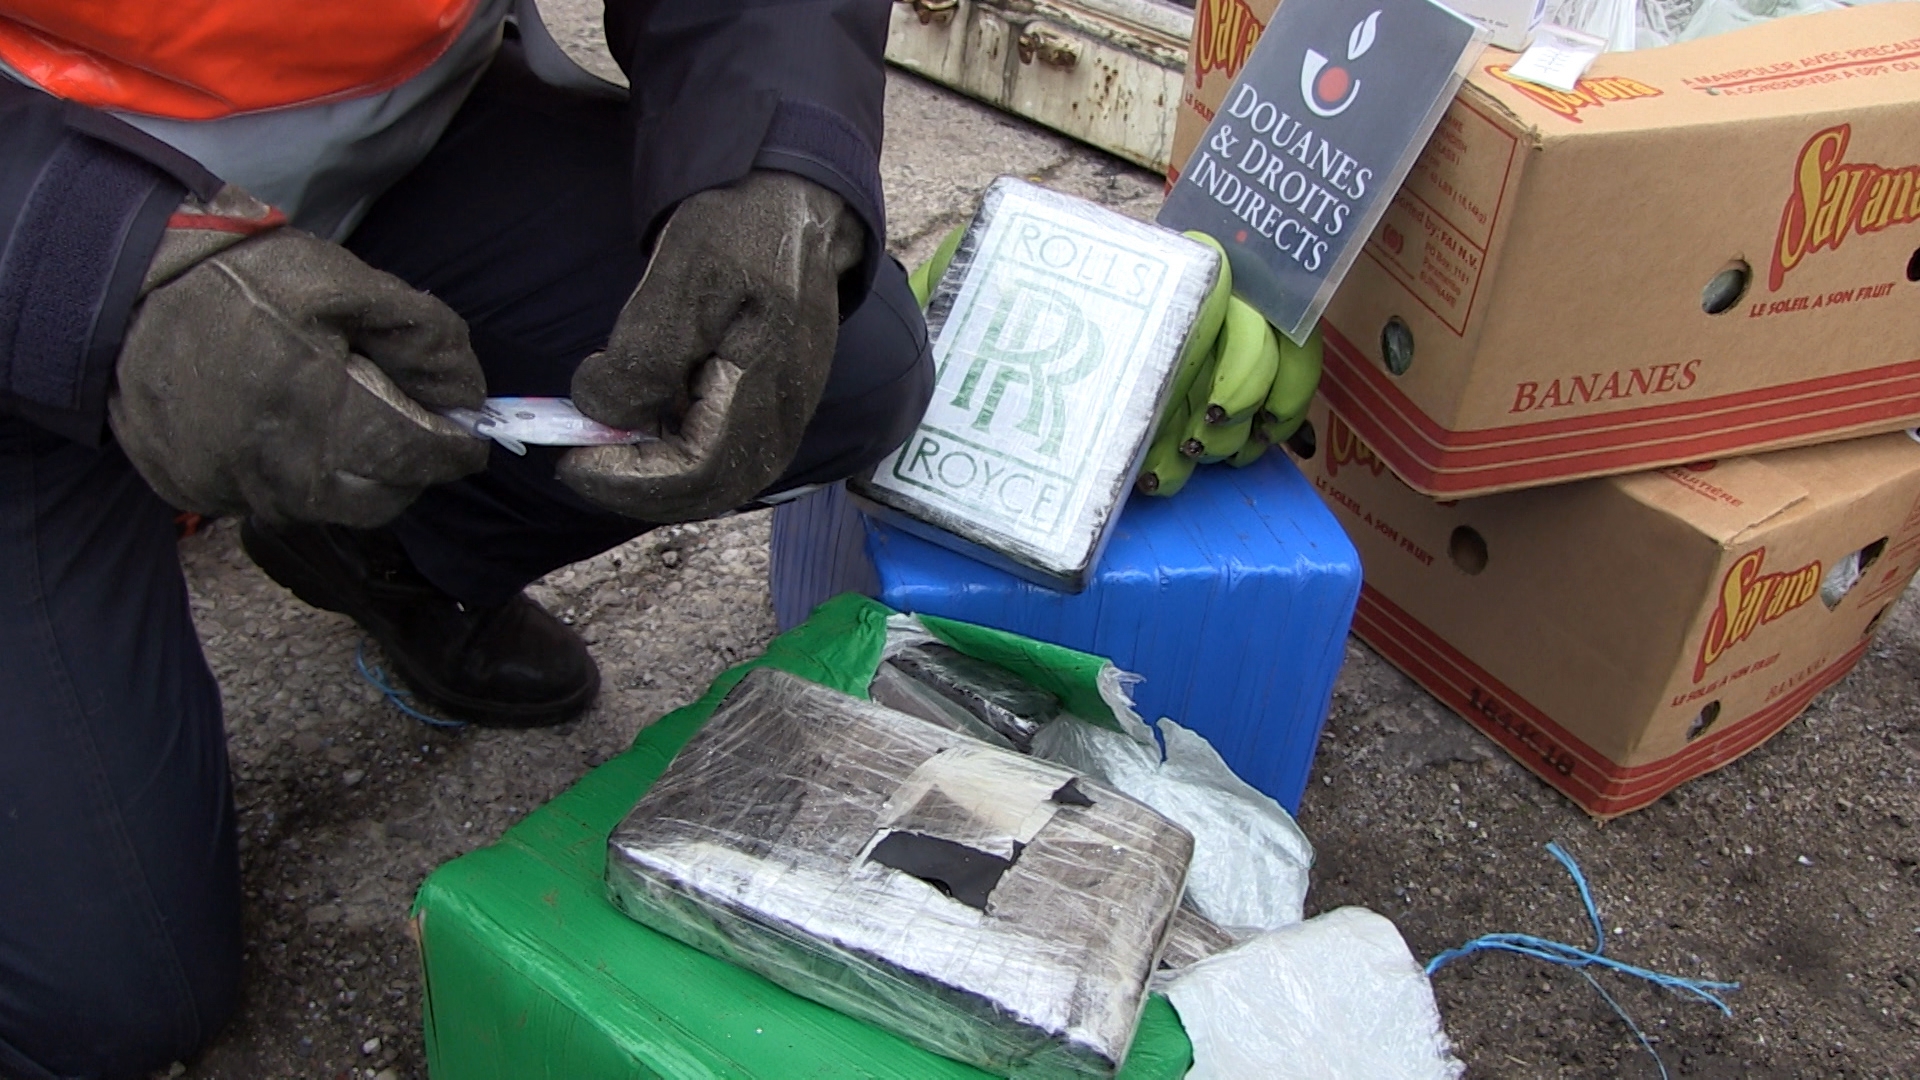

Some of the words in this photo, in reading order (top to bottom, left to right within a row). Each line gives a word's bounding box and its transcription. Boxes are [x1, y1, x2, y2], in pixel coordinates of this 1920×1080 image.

[1799, 51, 1847, 68] AVEC
[1210, 124, 1239, 158] &
[1237, 138, 1350, 236] DROITS
[1228, 83, 1373, 200] DOUANES
[1188, 152, 1329, 272] INDIRECTS
[1011, 222, 1152, 299] ROLLS
[1749, 303, 1767, 318] LE
[1767, 296, 1810, 316] SOLEIL
[1811, 294, 1823, 310] A
[1825, 288, 1854, 307] SON
[1855, 281, 1897, 302] FRUIT
[1508, 359, 1701, 414] BANANES
[907, 436, 1058, 521] ROYCE
[1364, 511, 1373, 526] A
[1692, 545, 1822, 684] Savana
